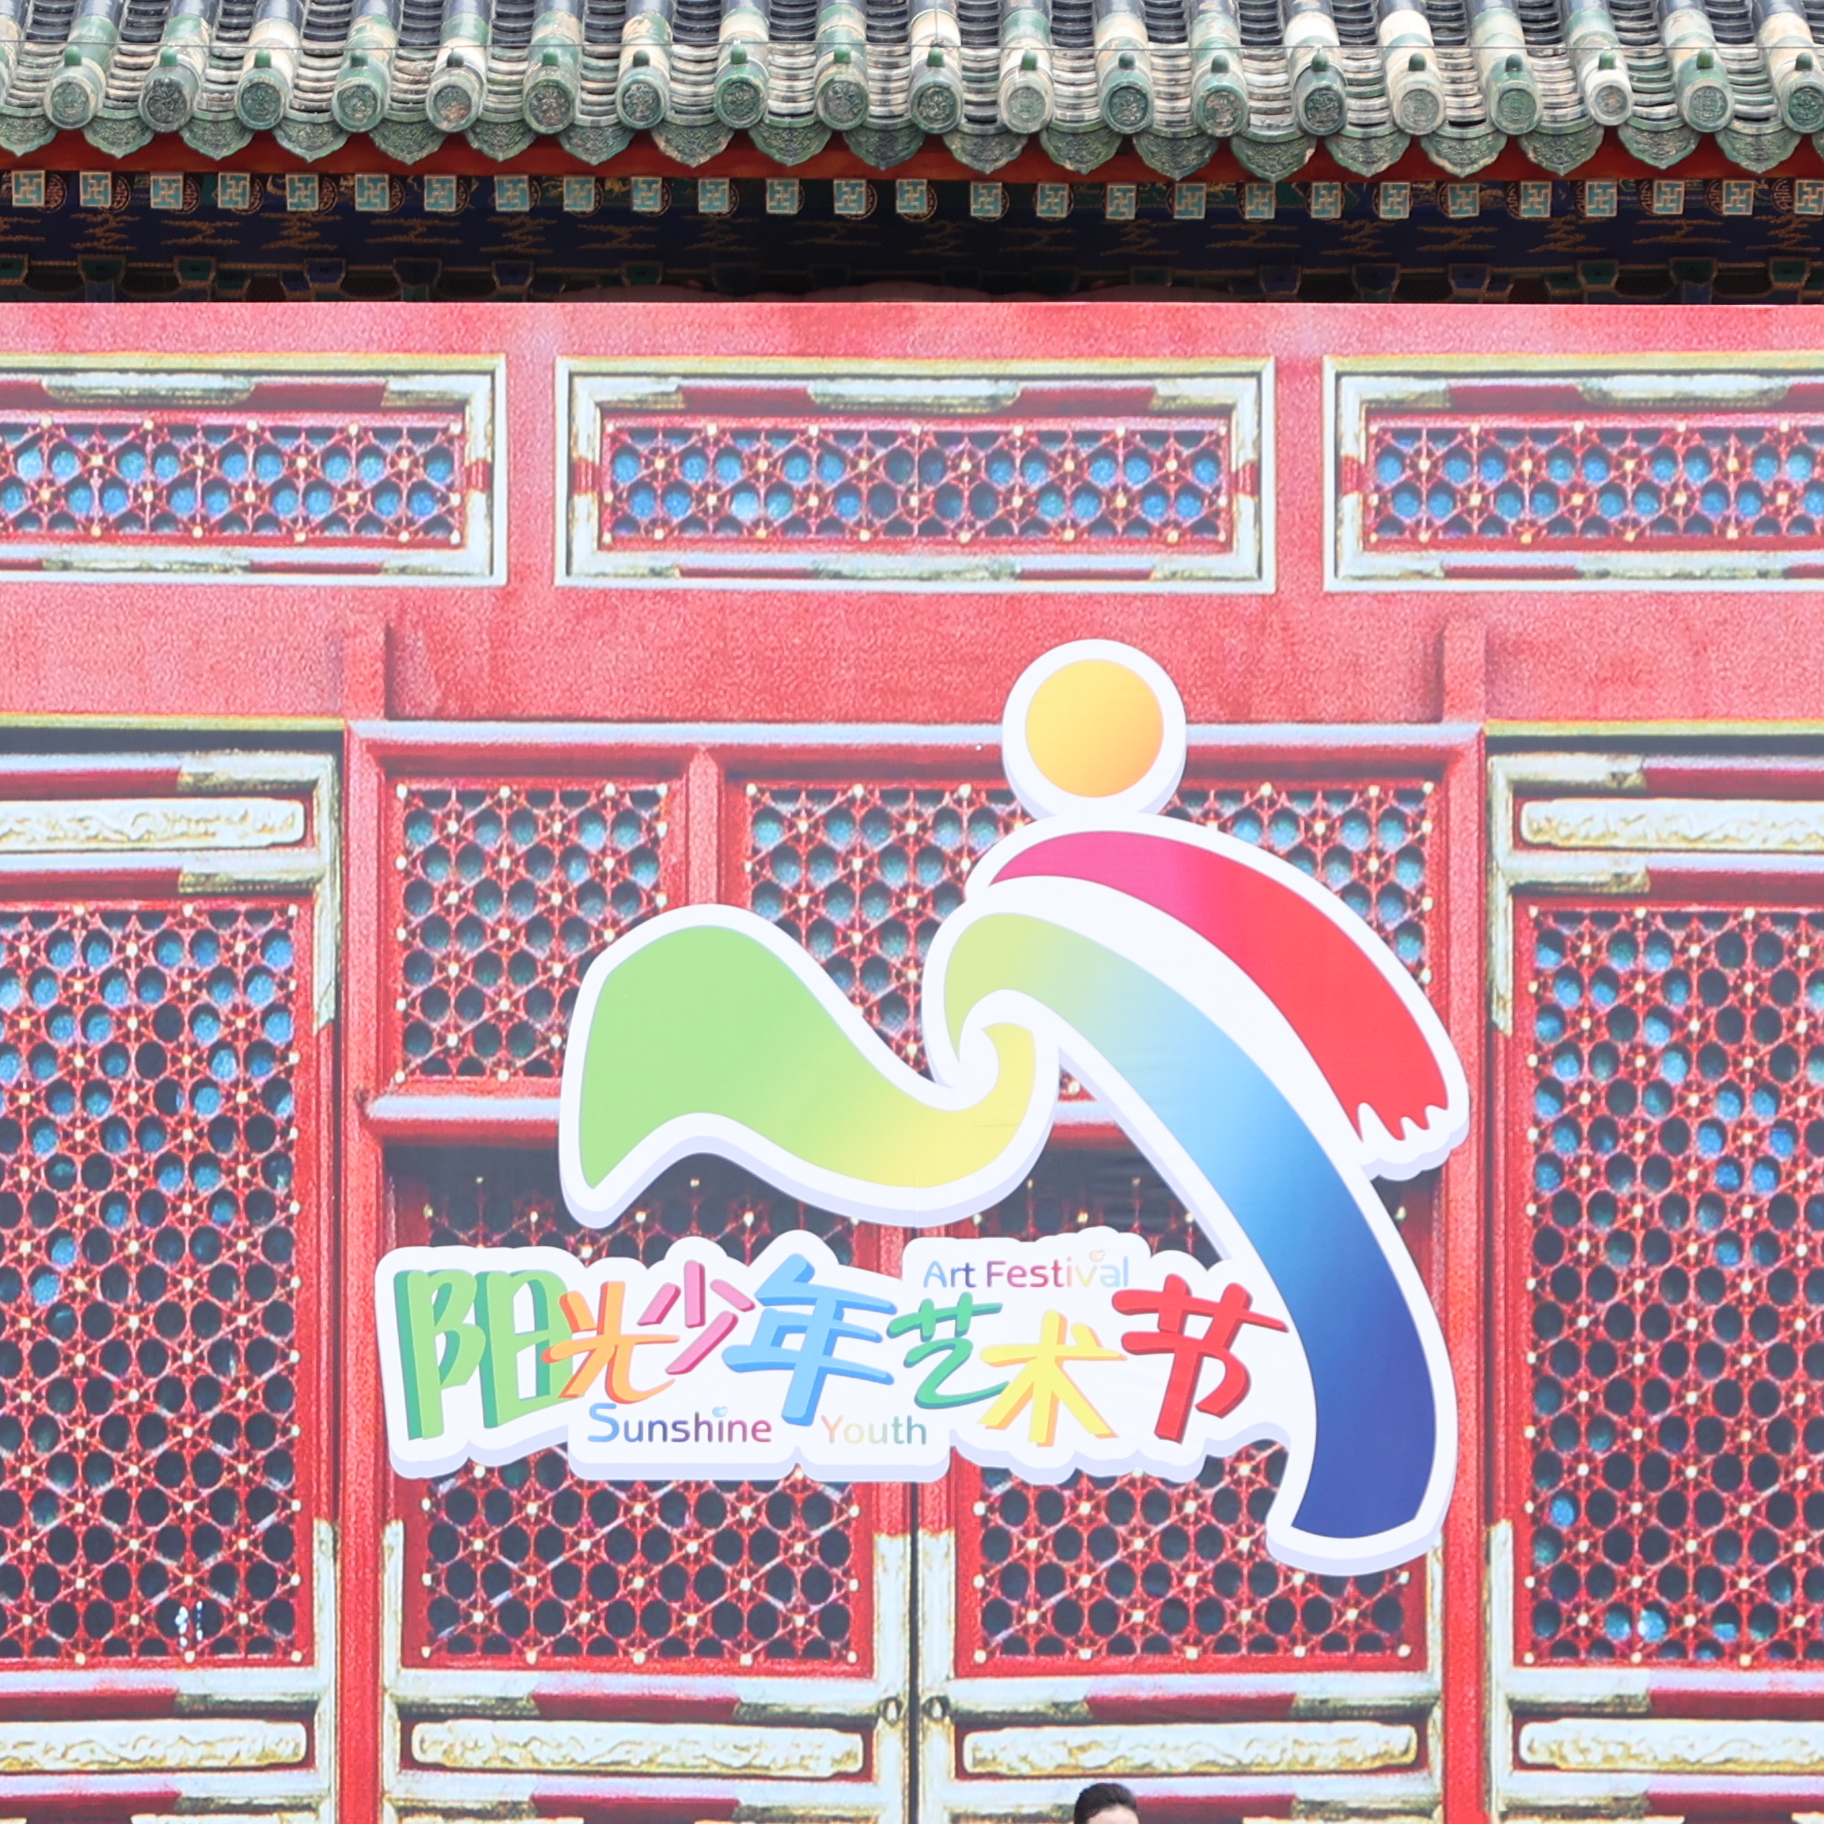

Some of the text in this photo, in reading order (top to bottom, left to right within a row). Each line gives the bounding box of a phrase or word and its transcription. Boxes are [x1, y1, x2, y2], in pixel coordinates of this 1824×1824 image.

[922, 1254, 1129, 1288] Art Festival
[393, 1252, 1289, 1447] 阳光少年艺术节
[587, 1402, 927, 1445] Sunshine Youth
